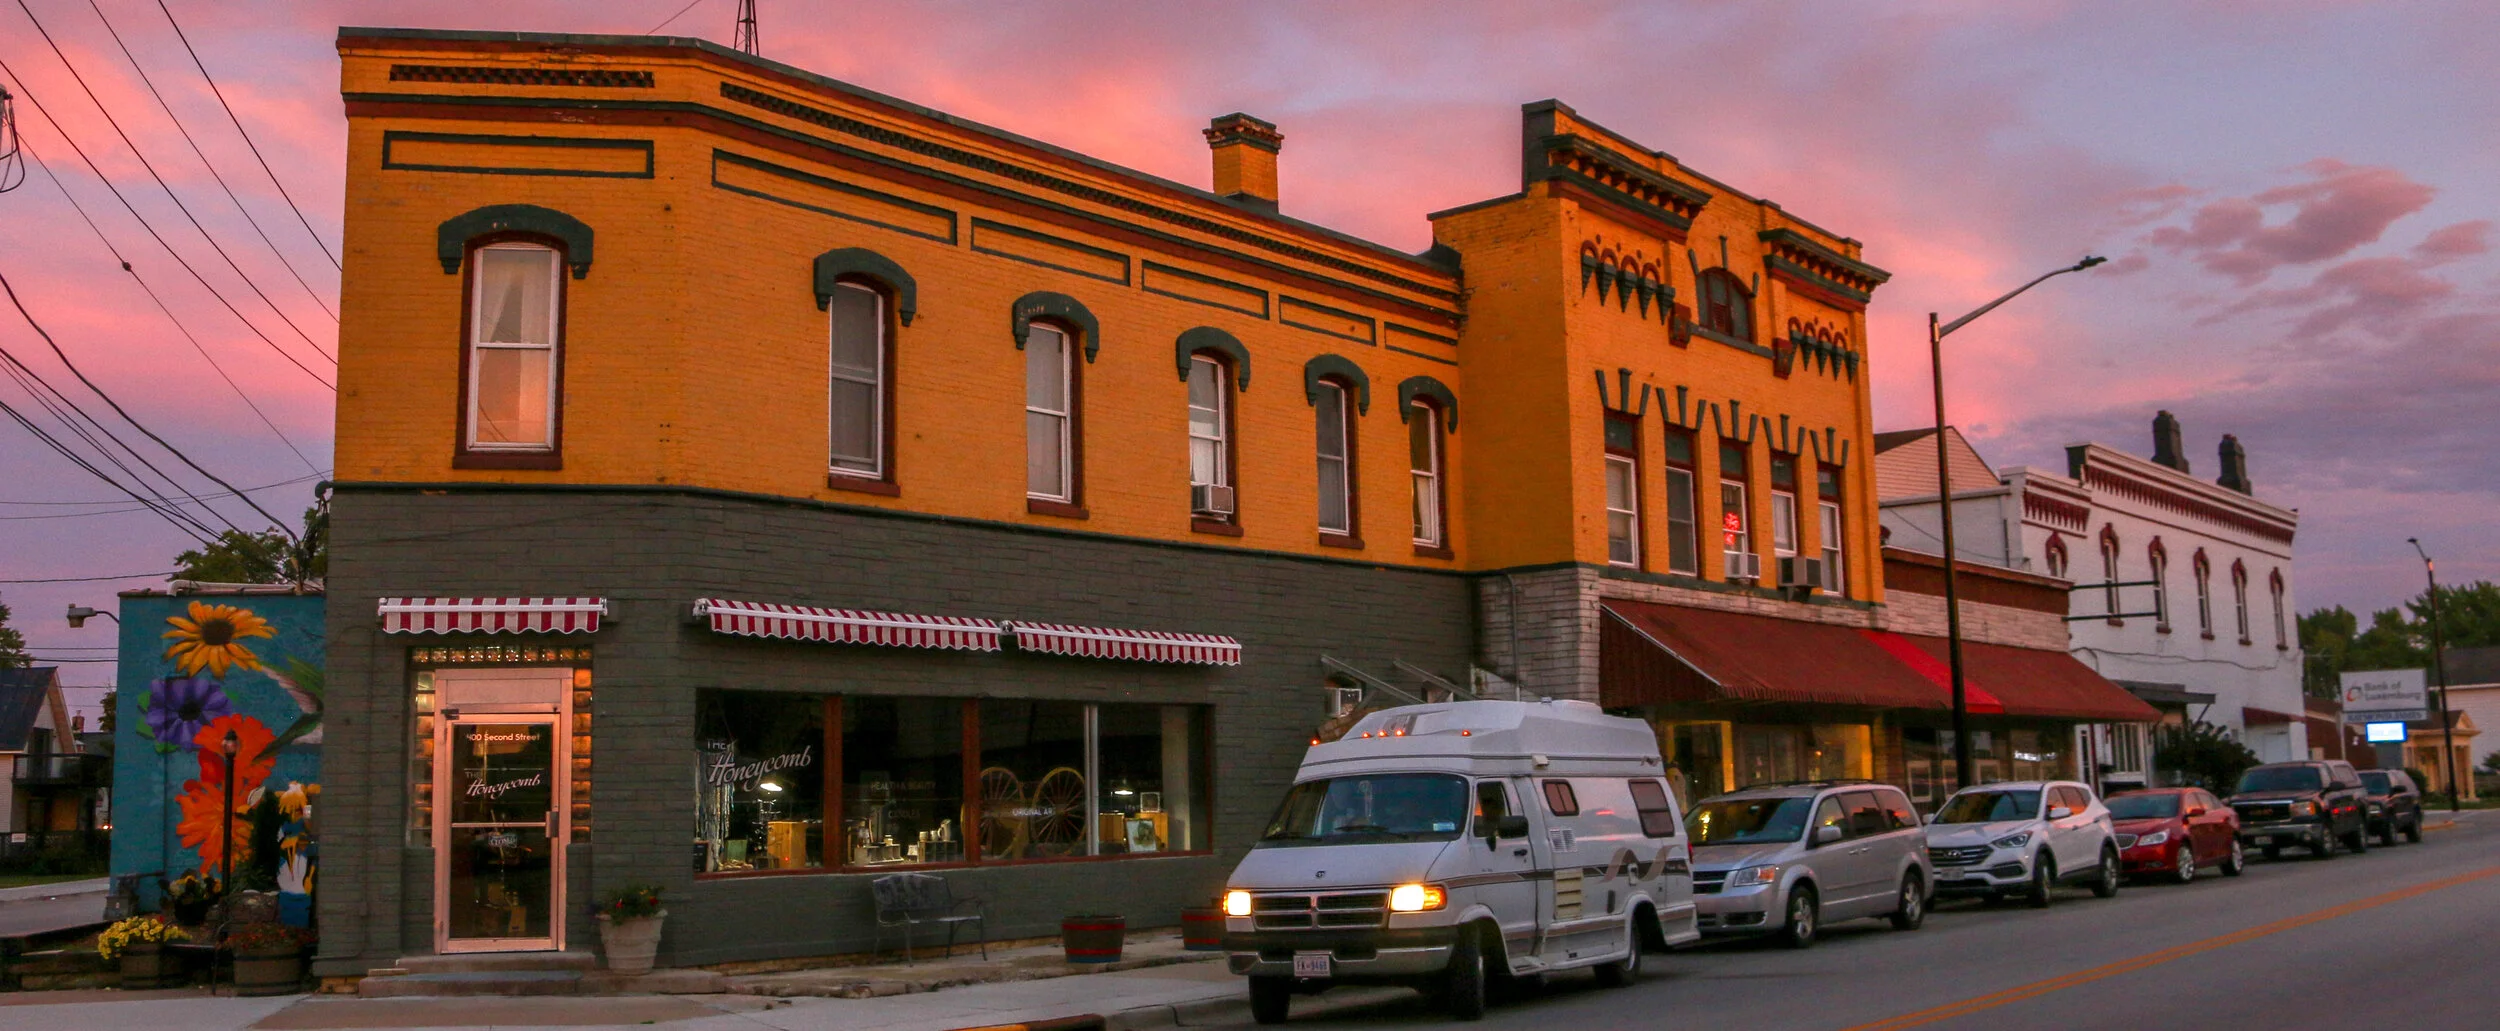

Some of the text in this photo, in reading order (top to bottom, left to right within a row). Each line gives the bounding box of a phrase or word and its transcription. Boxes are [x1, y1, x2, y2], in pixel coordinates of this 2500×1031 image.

[2365, 680, 2402, 691] Bank of
[484, 733, 513, 741] Second
[515, 733, 540, 741] Street
[707, 738, 727, 750] THE
[708, 744, 812, 793] Honeycomb
[466, 774, 541, 799] Honeycomb
